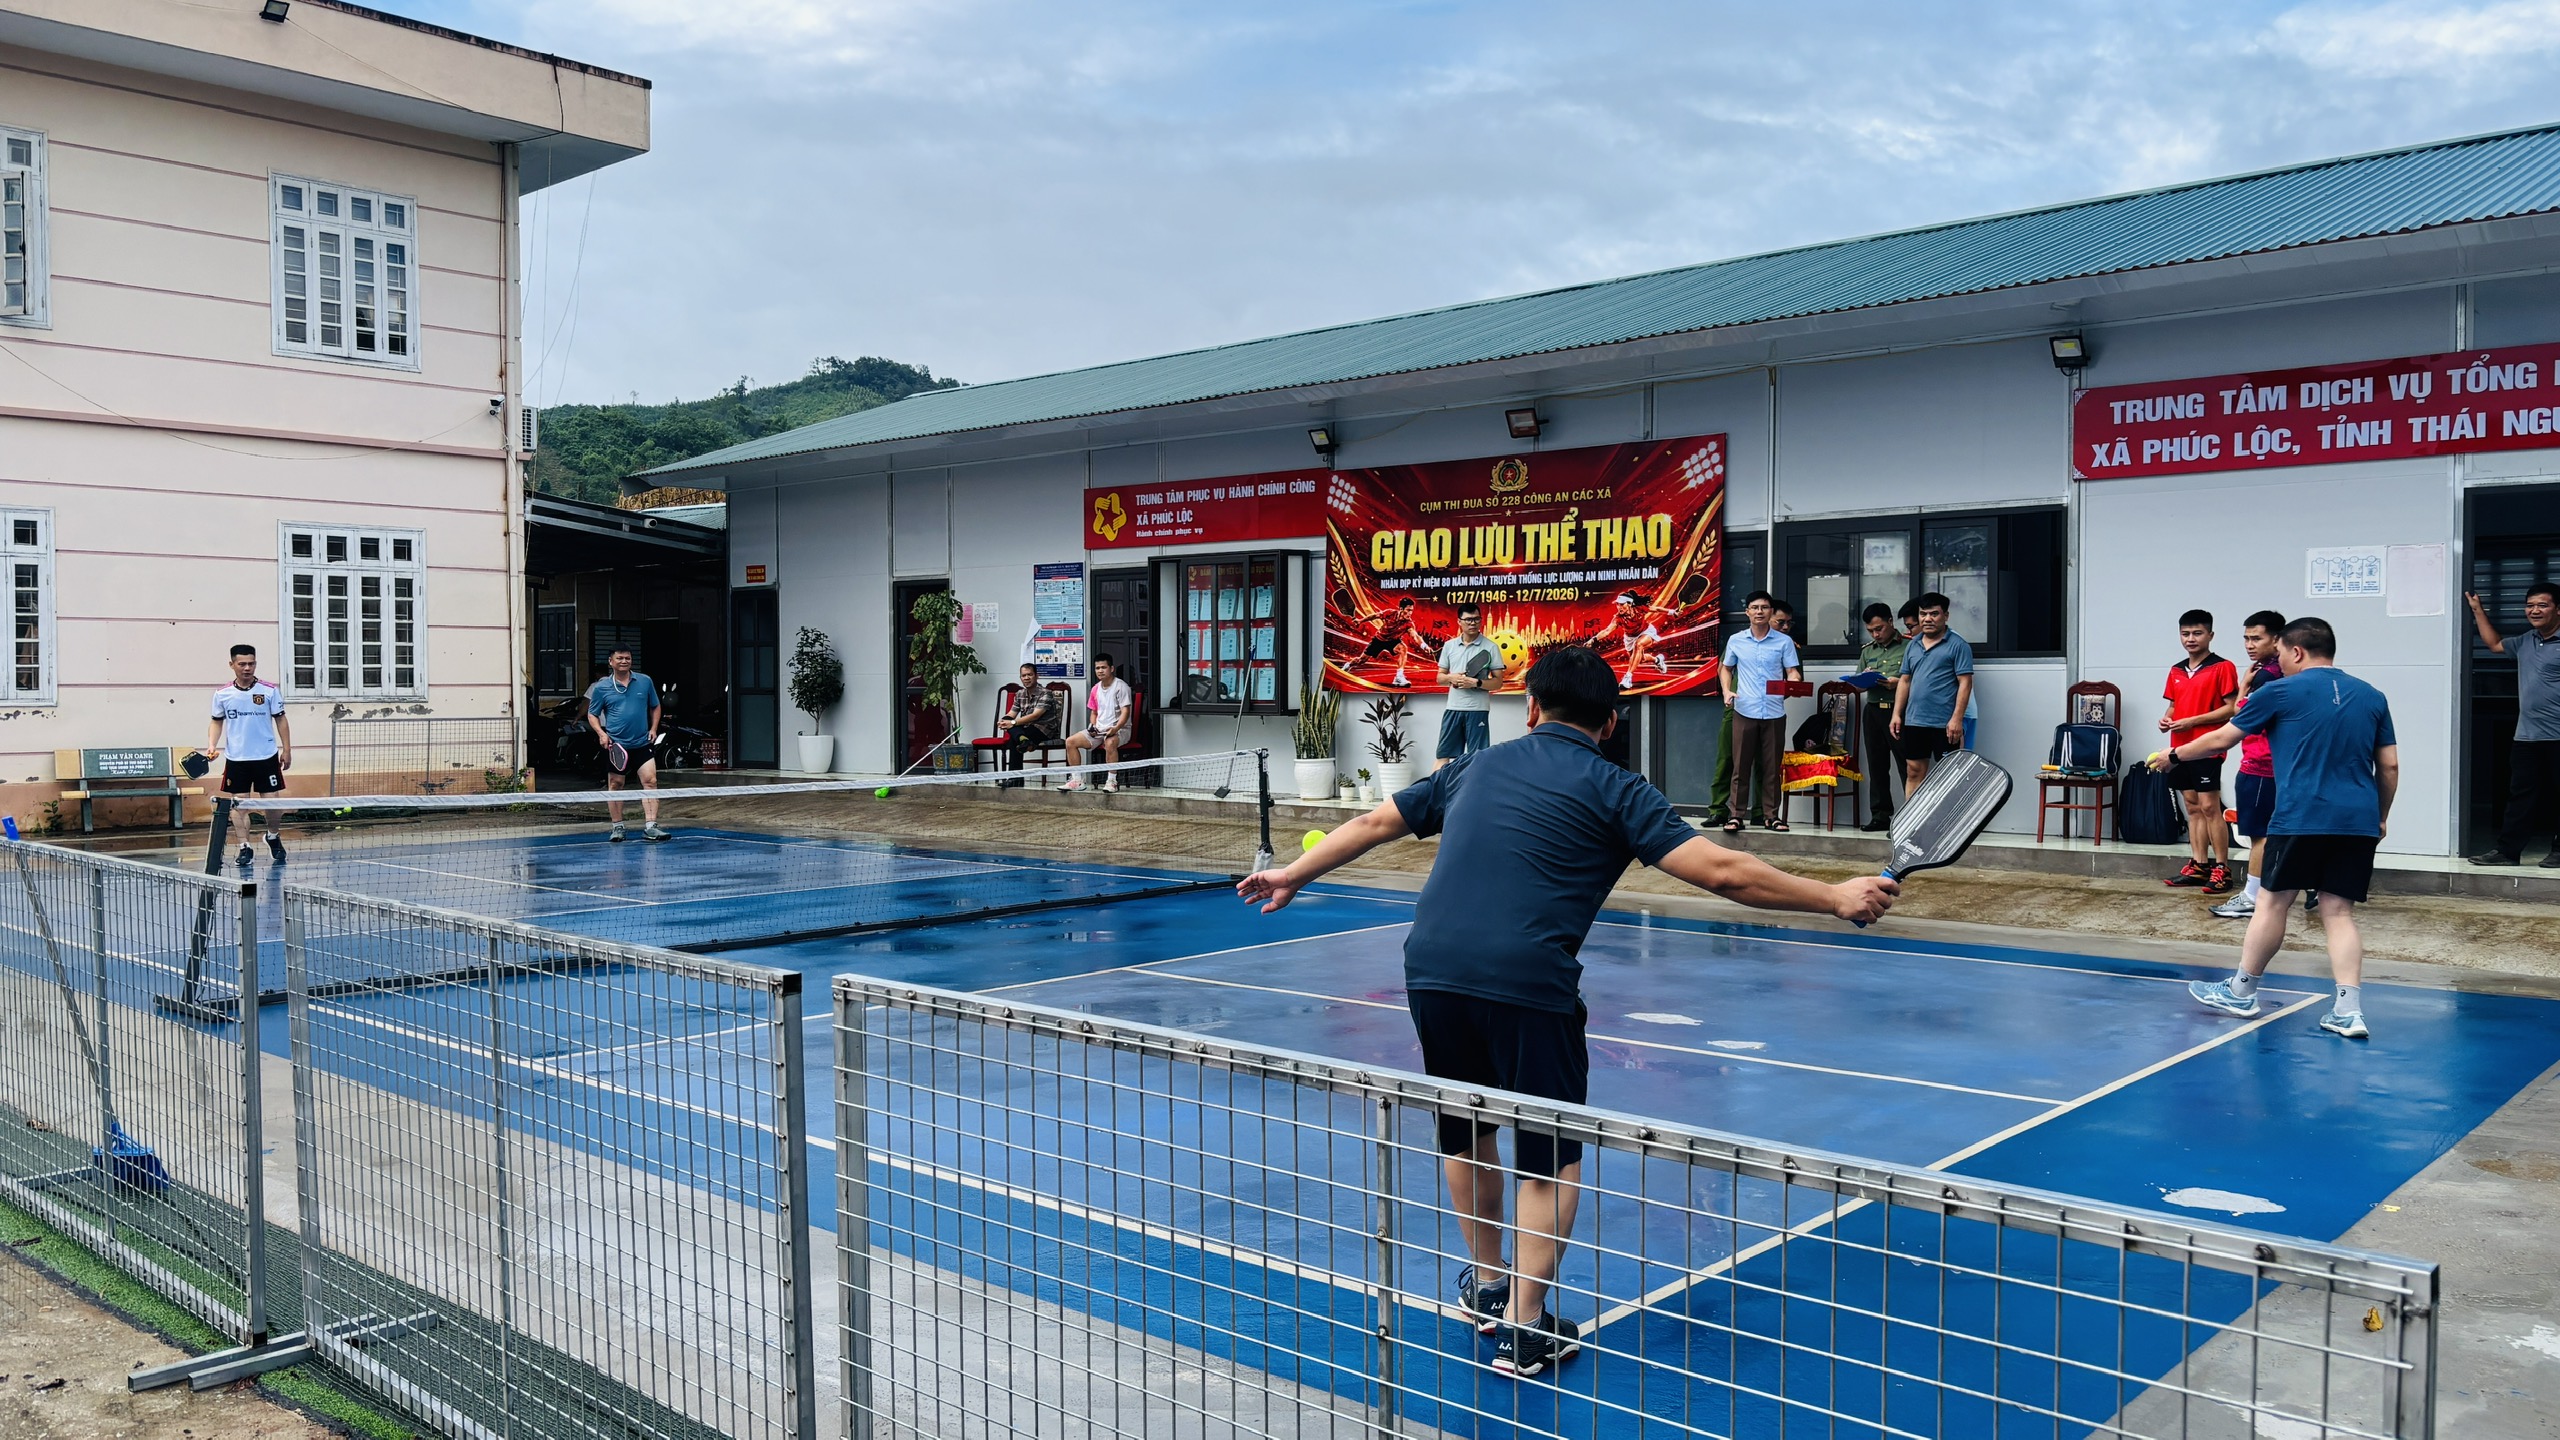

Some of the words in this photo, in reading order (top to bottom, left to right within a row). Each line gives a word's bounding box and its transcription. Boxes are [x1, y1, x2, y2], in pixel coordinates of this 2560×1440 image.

[2110, 392, 2205, 424] TRUNG
[2219, 384, 2287, 415] TÂM
[2300, 376, 2374, 412] DỊCH
[2388, 371, 2432, 404] VỤ
[2446, 354, 2538, 395] TỔNG
[2091, 438, 2130, 468] XÃ
[2142, 430, 2220, 464] PHÚC
[2234, 424, 2300, 460] LỘC,
[2317, 415, 2392, 450] TỈNH
[2408, 408, 2486, 444] THÁI
[1136, 493, 1163, 506] TRUNG
[1166, 490, 1184, 504] TÂM
[1187, 489, 1210, 502] PHỤC
[1213, 488, 1225, 502] VỤ
[1229, 484, 1254, 498] HÀNH
[1258, 480, 1286, 496] CHÍNH
[1290, 478, 1316, 493] CÔNG
[1420, 502, 1441, 514] CỤM
[1444, 500, 1460, 510] THI
[1463, 498, 1483, 509] ĐUA
[1486, 492, 1499, 507] SỐ
[1502, 496, 1520, 506] 228
[1524, 492, 1551, 504] CÔNG
[1554, 492, 1569, 502] AN
[1572, 488, 1594, 501] CÁC
[1596, 486, 1611, 499] XÃ
[1136, 511, 1149, 526] XÃ
[1151, 509, 1174, 524] PHÚC
[1176, 507, 1193, 524] LỘC
[1154, 528, 1173, 536] chính
[1175, 527, 1192, 536] phục
[1194, 527, 1203, 535] vụ
[1370, 528, 1452, 572] GIAO
[1458, 521, 1516, 566] LƯU
[1522, 507, 1579, 564] THỂ
[1582, 512, 1672, 561] THAO
[1380, 578, 1398, 589] NHÂN
[1400, 578, 1411, 590] DỊP
[1412, 576, 1422, 588] KỶ
[1423, 576, 1440, 589] NIỆM
[1442, 577, 1450, 587] 80
[1452, 575, 1468, 586] NĂM
[1469, 574, 1488, 586] NGÀY
[1518, 571, 1542, 584] THỐNG
[1544, 572, 1558, 585] LỰC
[1560, 571, 1584, 584] LƯỢNG
[1586, 571, 1596, 582] AN
[1598, 570, 1616, 581] NINH
[1618, 567, 1640, 580] NHÂN
[1642, 566, 1658, 579] DÂN
[1446, 590, 1506, 604] (12/7/1946
[1516, 587, 1579, 601] 12/7/2026)
[269, 774, 277, 786] 6
